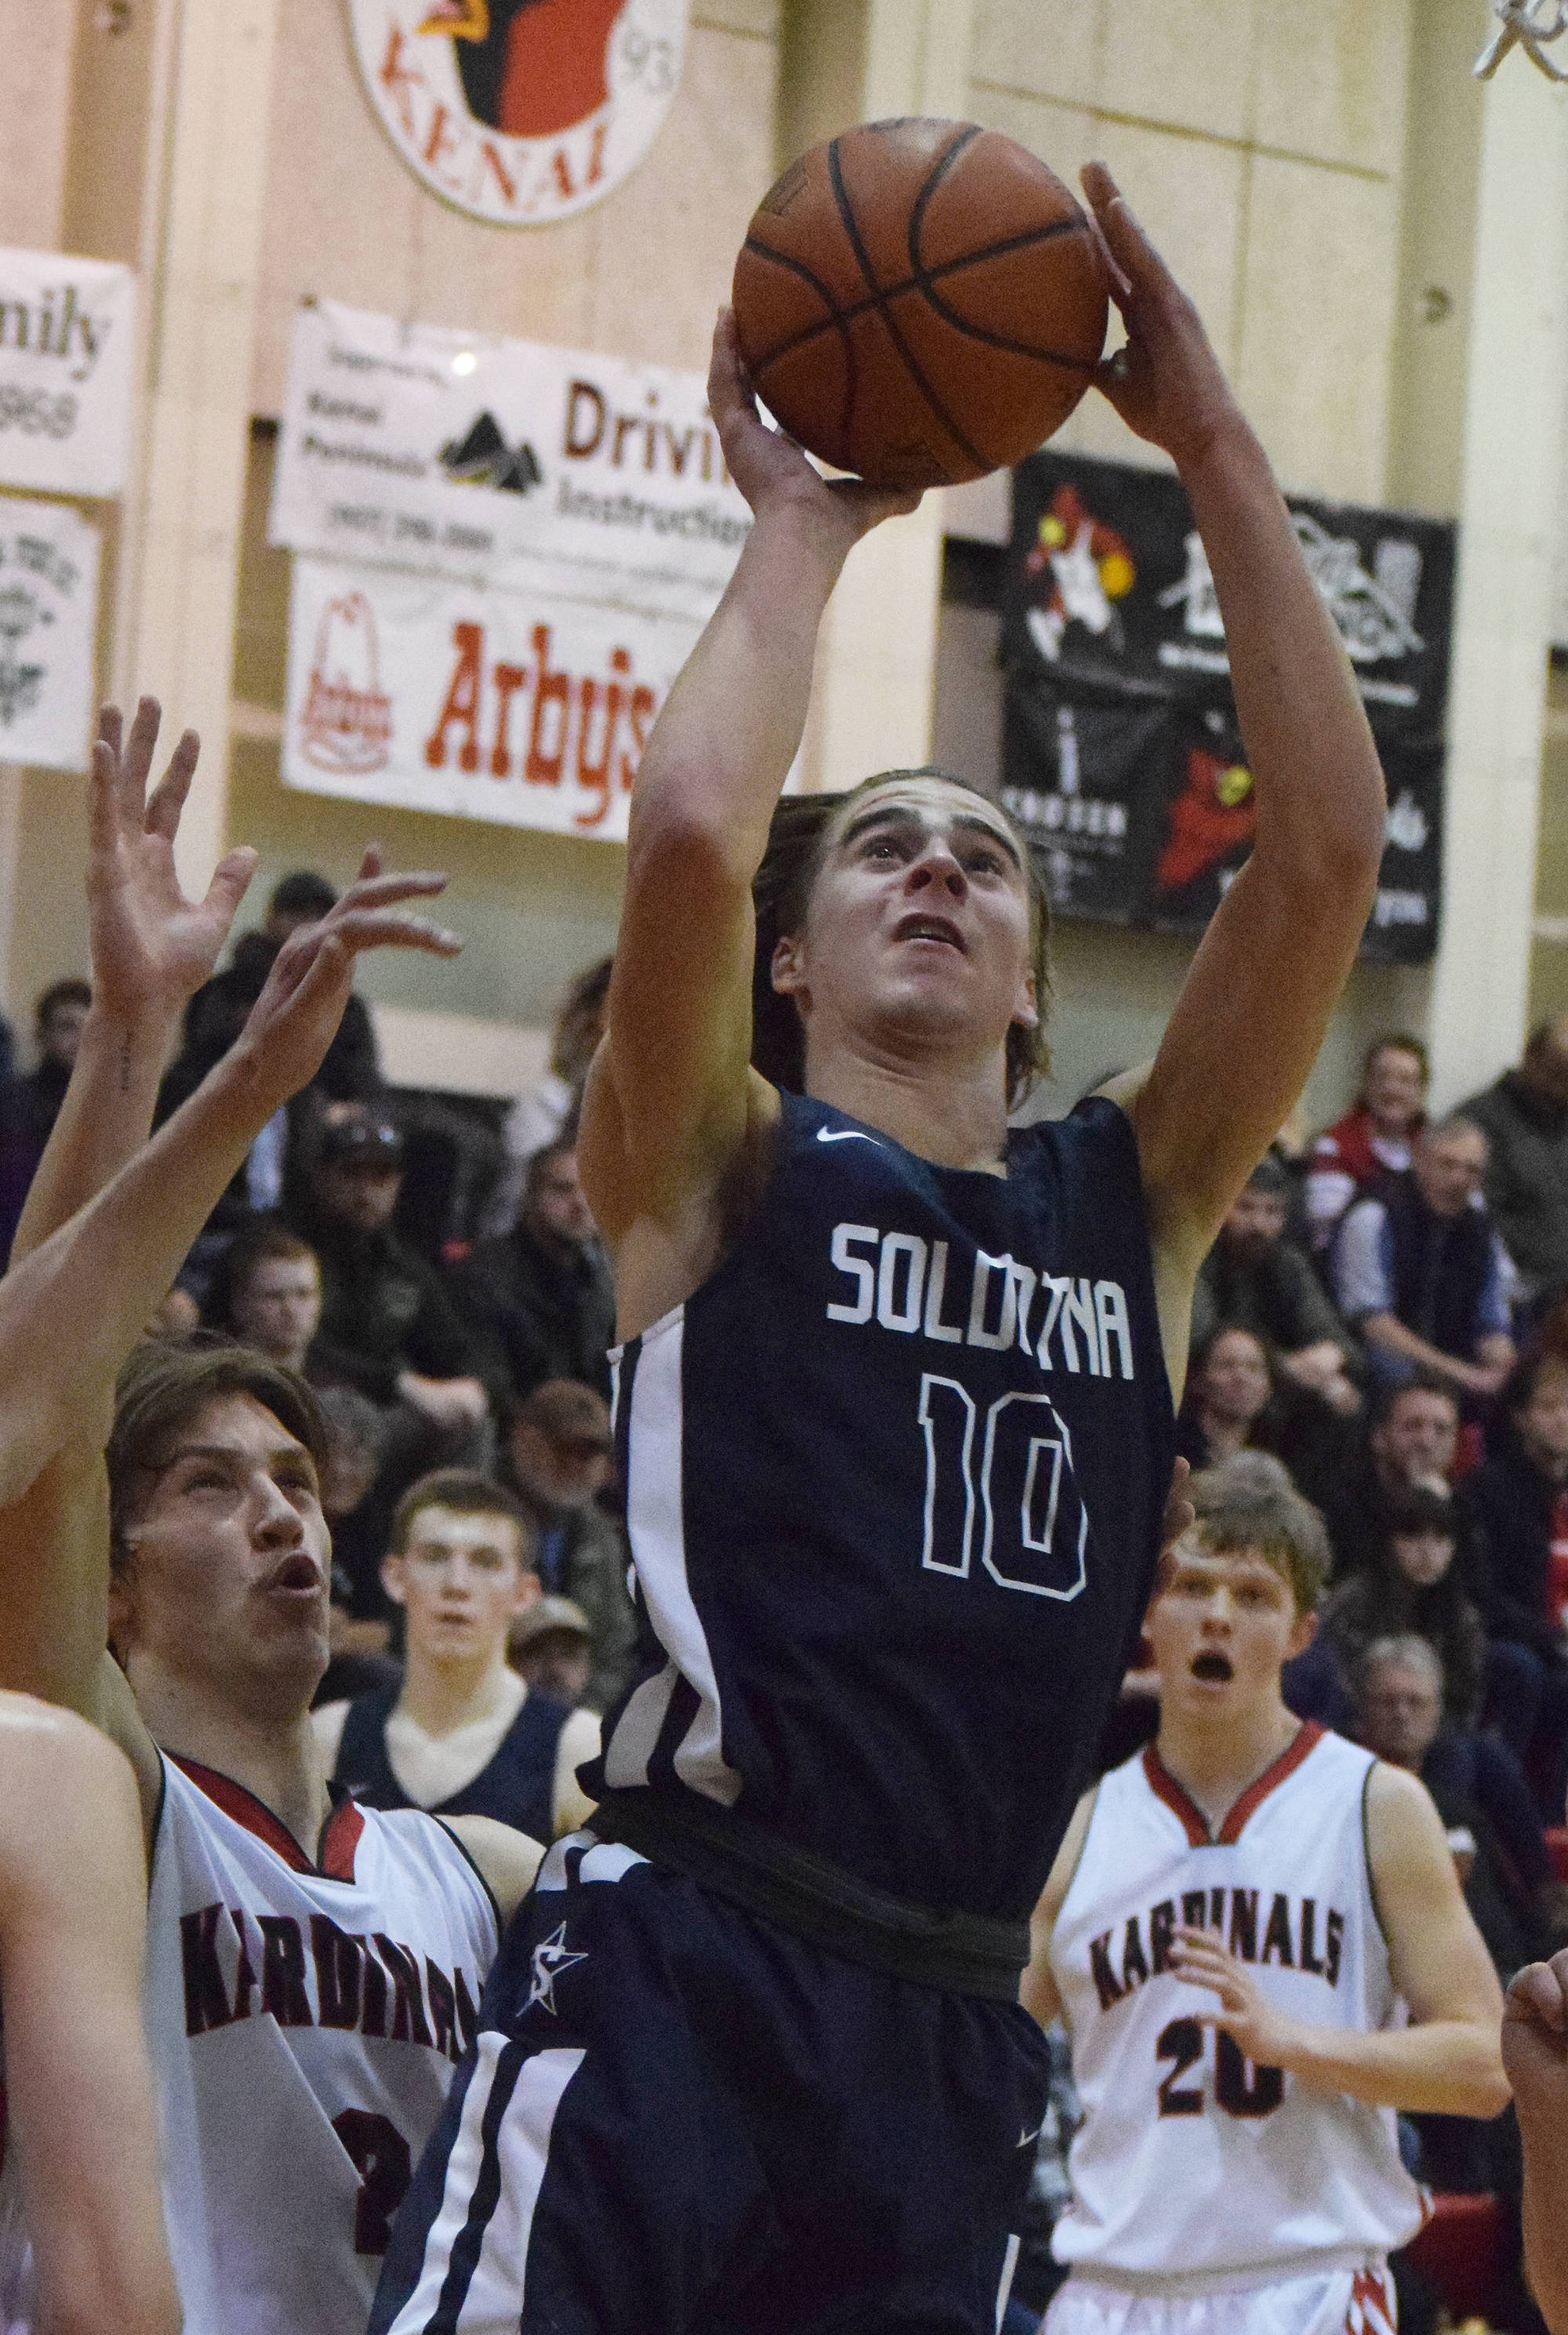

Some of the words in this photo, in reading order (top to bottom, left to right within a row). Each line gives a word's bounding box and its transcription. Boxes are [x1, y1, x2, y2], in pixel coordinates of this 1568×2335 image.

[379, 21, 608, 212] KENAI
[917, 1372, 1089, 1603] 10
[1156, 2015, 1286, 2119] 20
